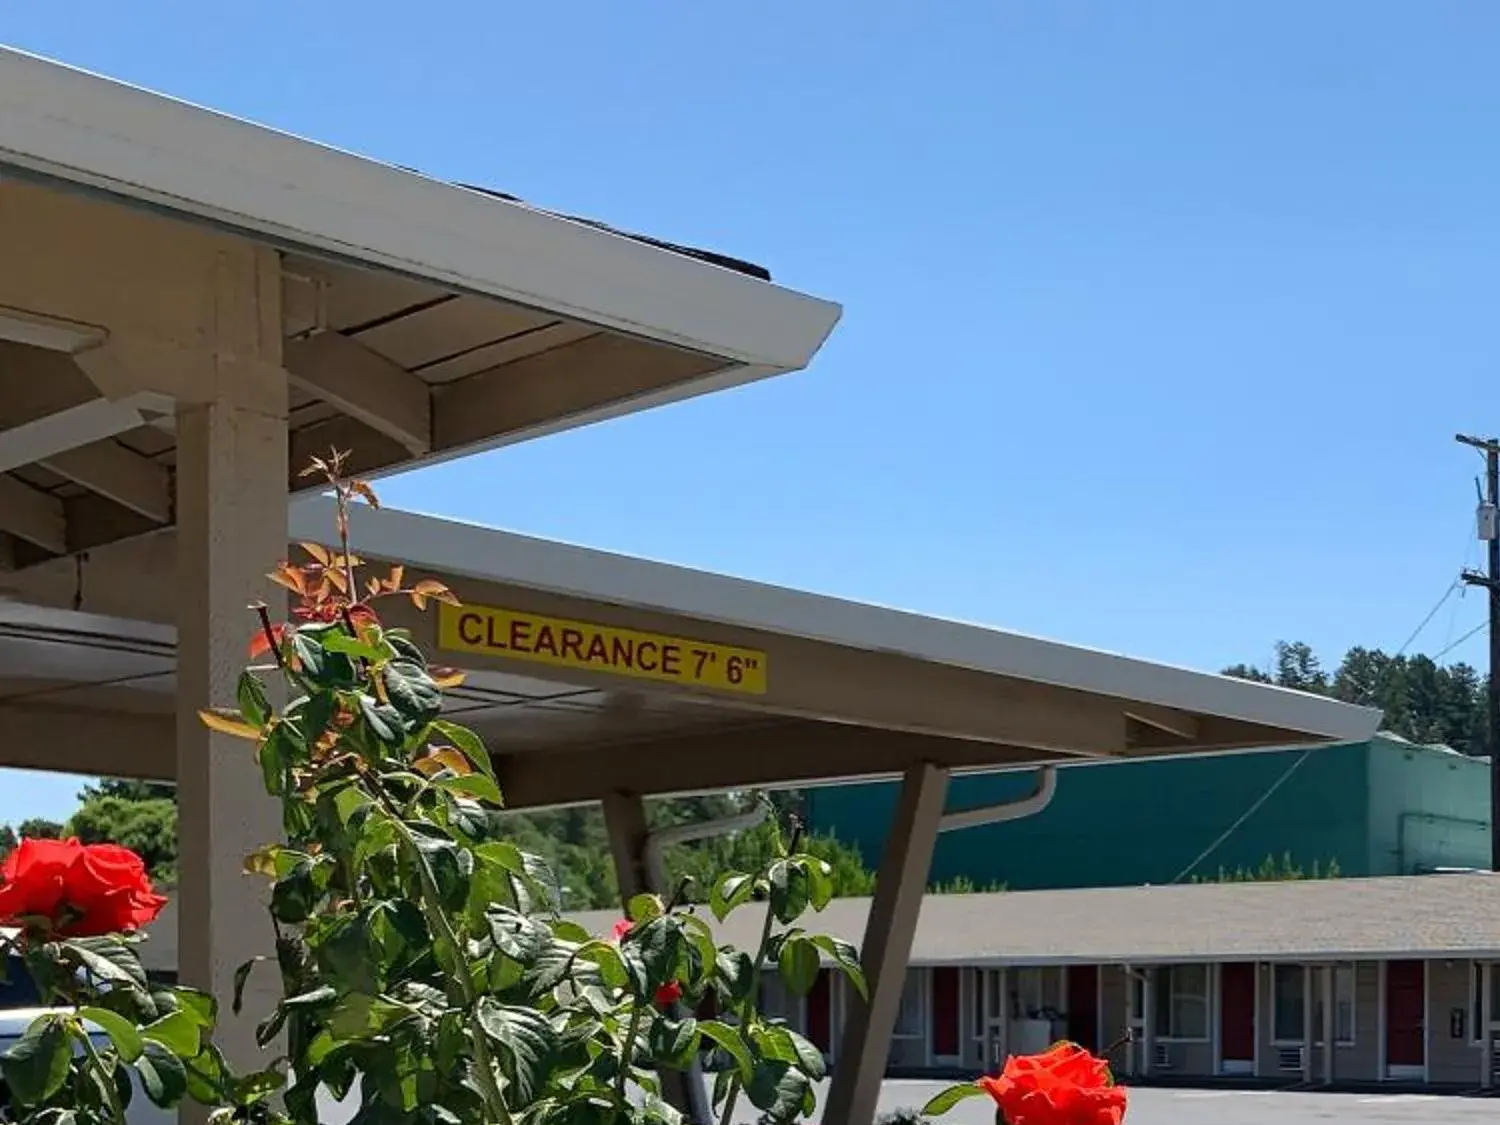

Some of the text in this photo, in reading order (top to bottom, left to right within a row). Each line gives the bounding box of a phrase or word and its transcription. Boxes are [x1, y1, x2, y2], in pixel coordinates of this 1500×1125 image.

[457, 611, 758, 685] CLEARANCE 7' 6"
